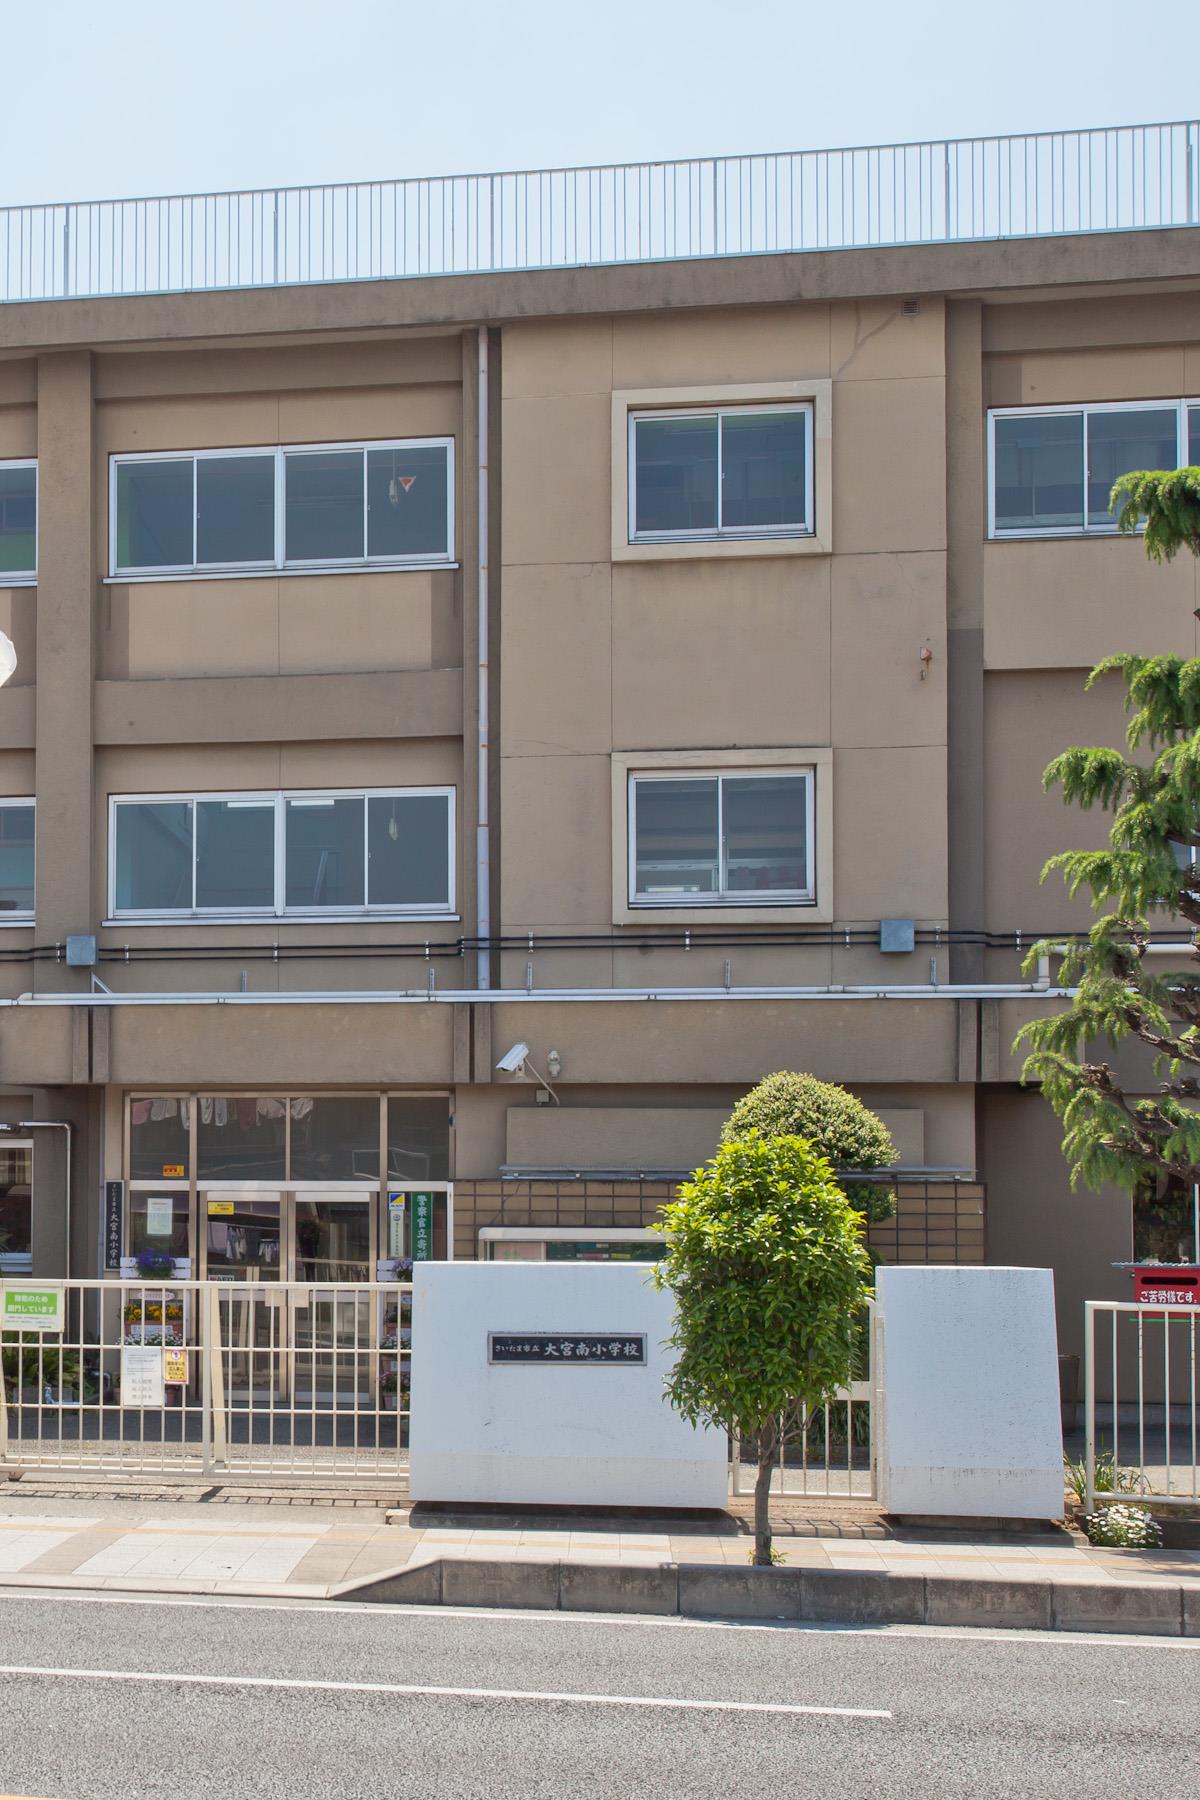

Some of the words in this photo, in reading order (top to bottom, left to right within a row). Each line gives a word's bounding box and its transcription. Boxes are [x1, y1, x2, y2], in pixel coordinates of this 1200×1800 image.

[109, 1213, 120, 1267] 大宮南小学校
[416, 1194, 428, 1260] 警察官立寄所
[495, 1344, 540, 1353] さいたま市立
[543, 1341, 640, 1357] 大宮南小学校
